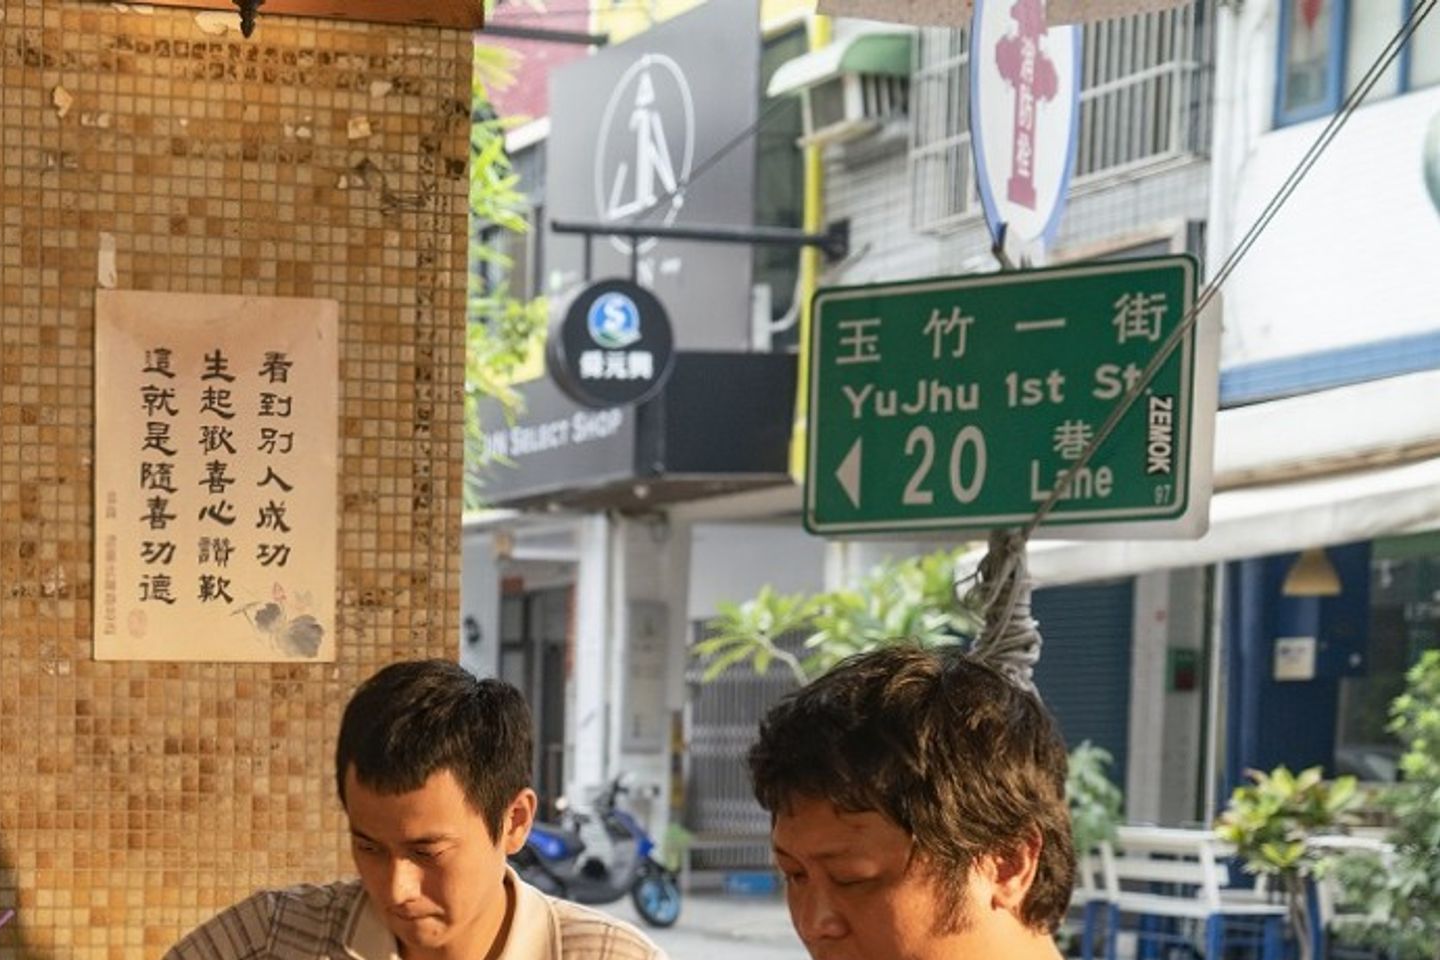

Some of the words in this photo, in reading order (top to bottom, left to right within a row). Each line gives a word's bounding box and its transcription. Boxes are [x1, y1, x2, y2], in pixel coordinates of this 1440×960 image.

[835, 291, 1169, 367] 玉竹一街
[842, 379, 980, 419] YuJhu
[1005, 369, 1067, 407] 1st
[255, 350, 295, 568] 看到別人成功
[901, 424, 989, 506] 20
[1053, 419, 1094, 461] 巷
[1147, 396, 1173, 475] ZEMOK
[138, 347, 180, 606] 這就是隨喜功德
[1030, 459, 1114, 501] Lane
